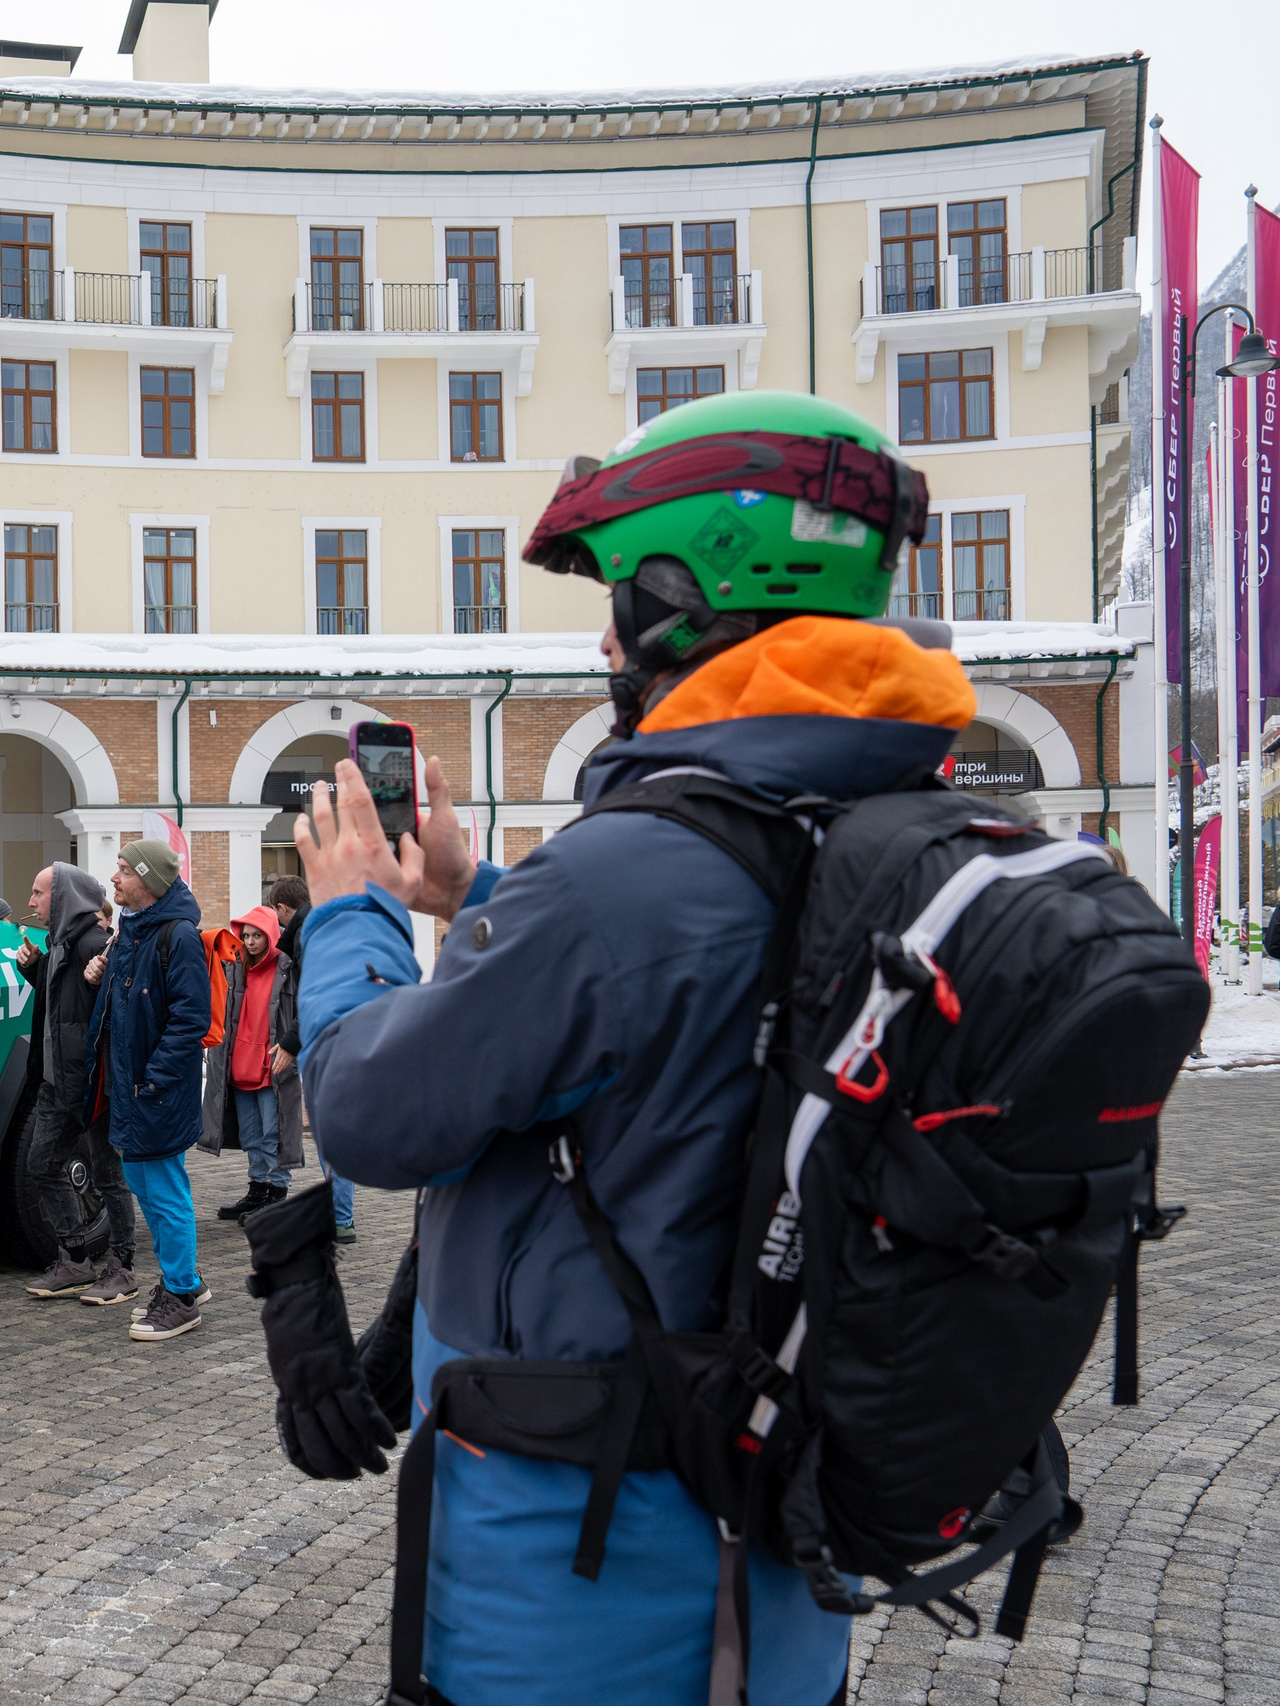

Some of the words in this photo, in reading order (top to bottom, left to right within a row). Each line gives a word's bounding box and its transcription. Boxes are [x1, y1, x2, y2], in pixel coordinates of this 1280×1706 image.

[1171, 288, 1182, 405] Первый
[1261, 339, 1278, 446] Первй
[1167, 413, 1178, 502] СБЕР
[955, 762, 987, 774] три
[955, 773, 1024, 786] вершины
